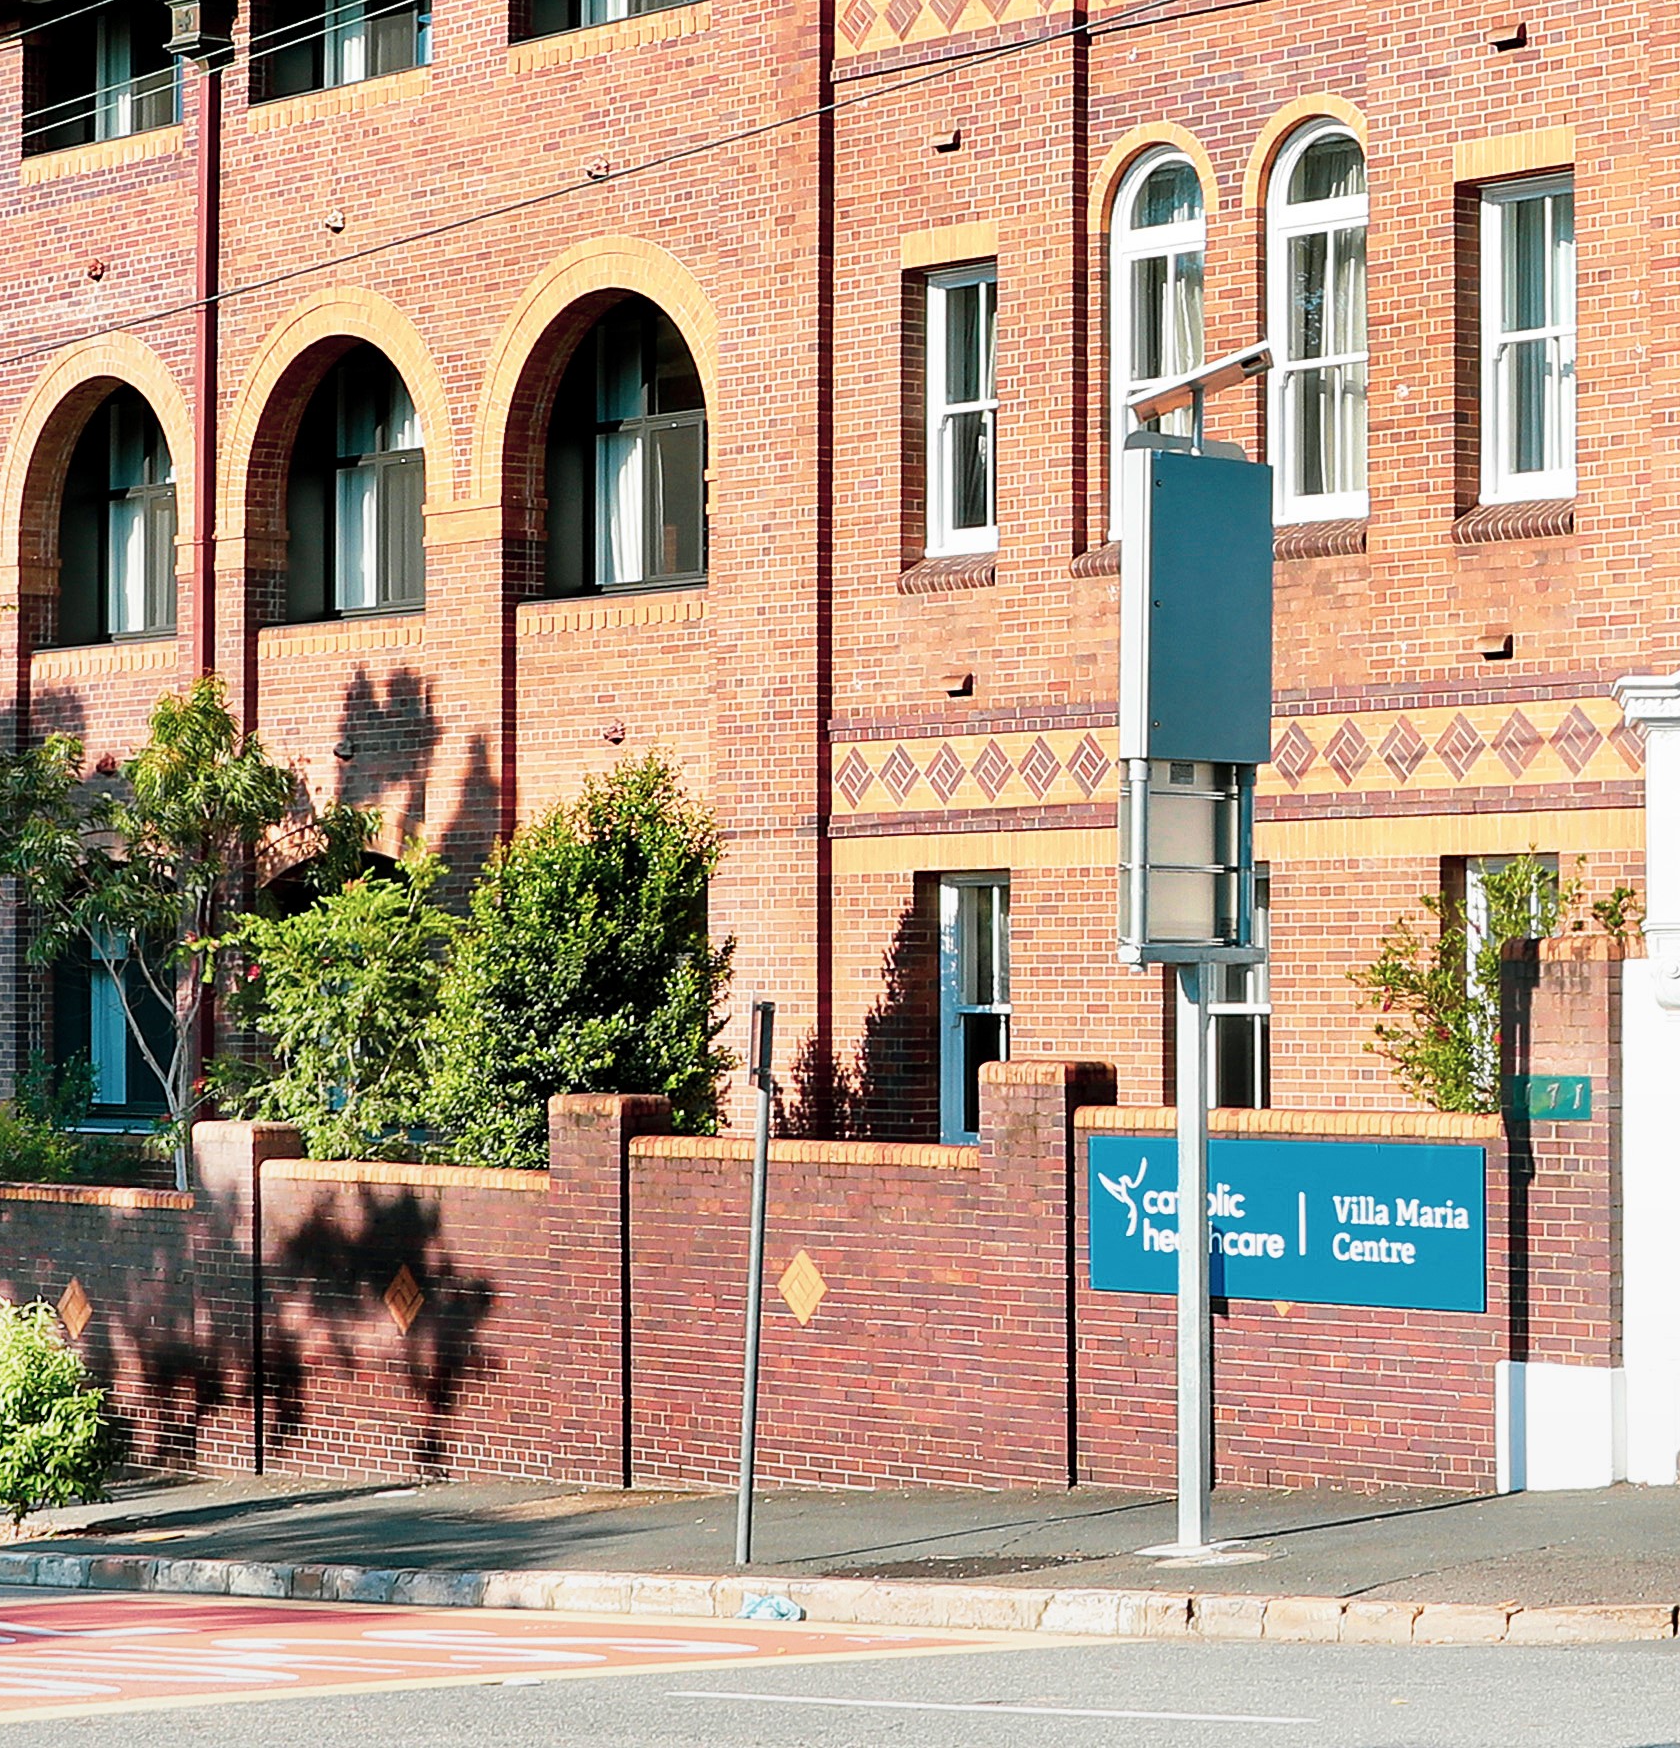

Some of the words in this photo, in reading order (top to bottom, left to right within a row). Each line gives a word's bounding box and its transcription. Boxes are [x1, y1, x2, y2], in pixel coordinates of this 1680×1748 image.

[1332, 1195, 1390, 1226] Villa
[1395, 1199, 1470, 1229] Maria
[1143, 1217, 1285, 1258] hehcare
[1332, 1232, 1416, 1264] Centre
